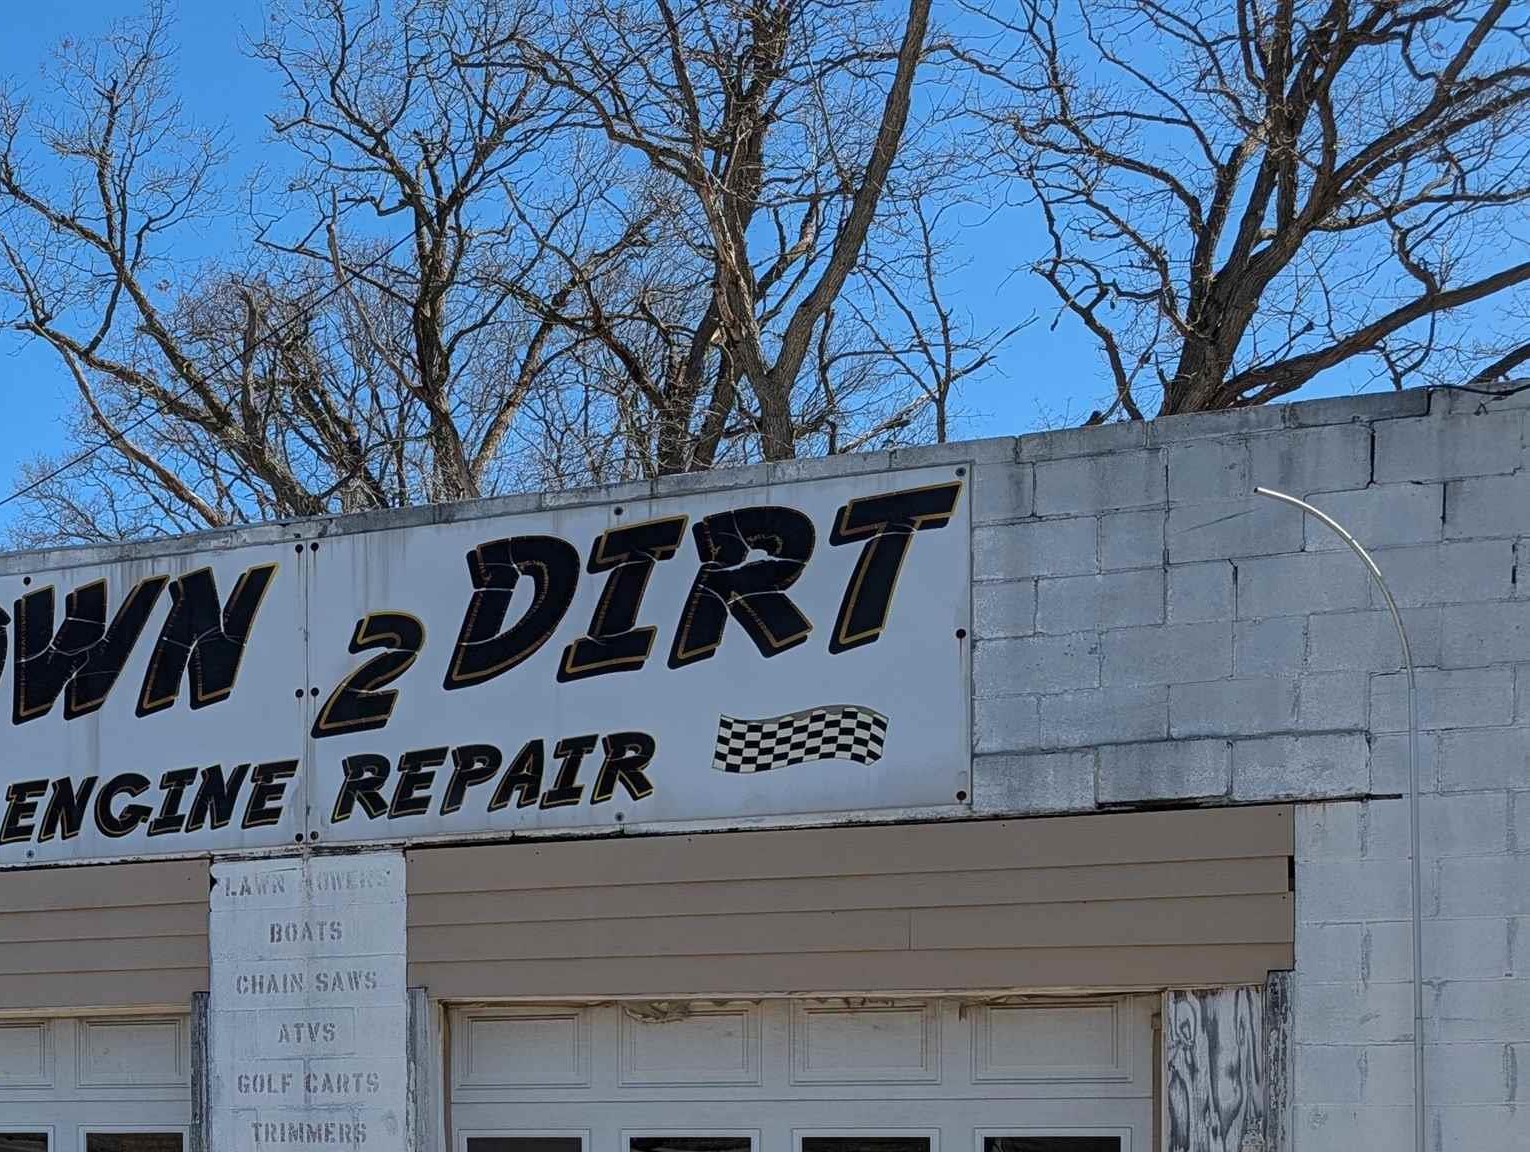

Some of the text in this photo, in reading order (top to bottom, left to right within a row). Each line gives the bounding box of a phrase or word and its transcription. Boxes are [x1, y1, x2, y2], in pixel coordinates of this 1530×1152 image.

[310, 611, 425, 739] 2
[443, 480, 961, 692] DIRT
[331, 729, 654, 825] REPAIR
[269, 920, 343, 944] BOATS
[236, 971, 378, 996] CHAIN SAWS
[237, 1072, 380, 1095] GOLF CARTS
[251, 1121, 368, 1144] TRIMMERS
